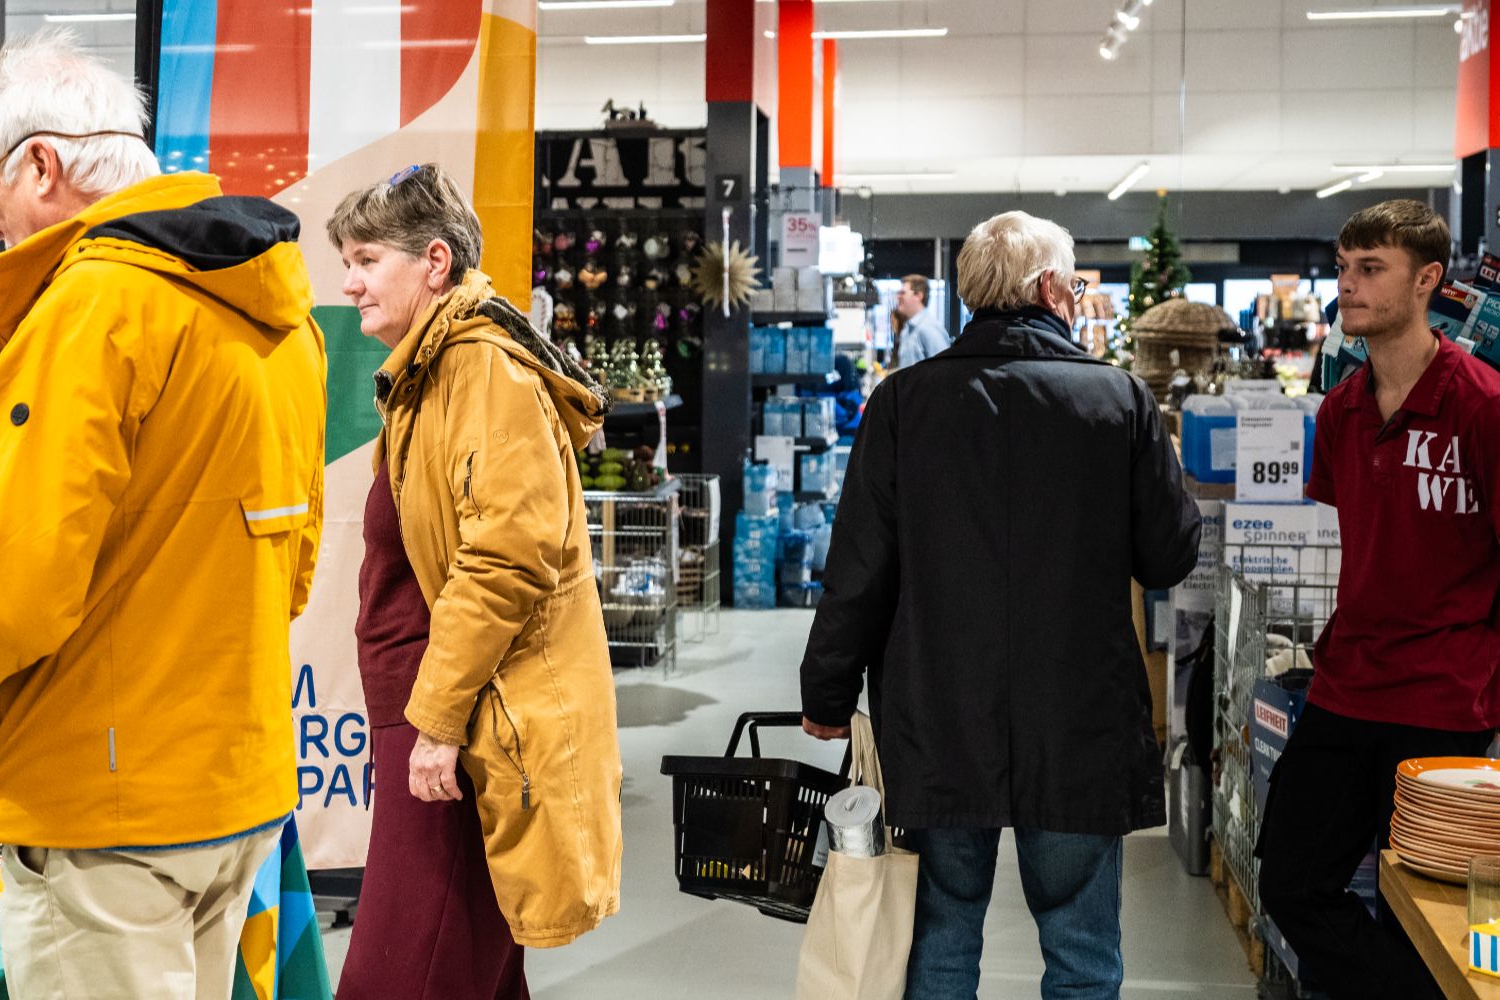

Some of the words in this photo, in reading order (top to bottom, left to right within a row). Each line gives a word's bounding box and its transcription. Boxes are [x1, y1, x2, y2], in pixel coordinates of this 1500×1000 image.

[722, 179, 735, 197] 7
[1253, 461, 1299, 484] 89.99
[1233, 519, 1274, 530] ezee
[1256, 703, 1287, 732] LEIFHEIT
[296, 712, 367, 759] RG
